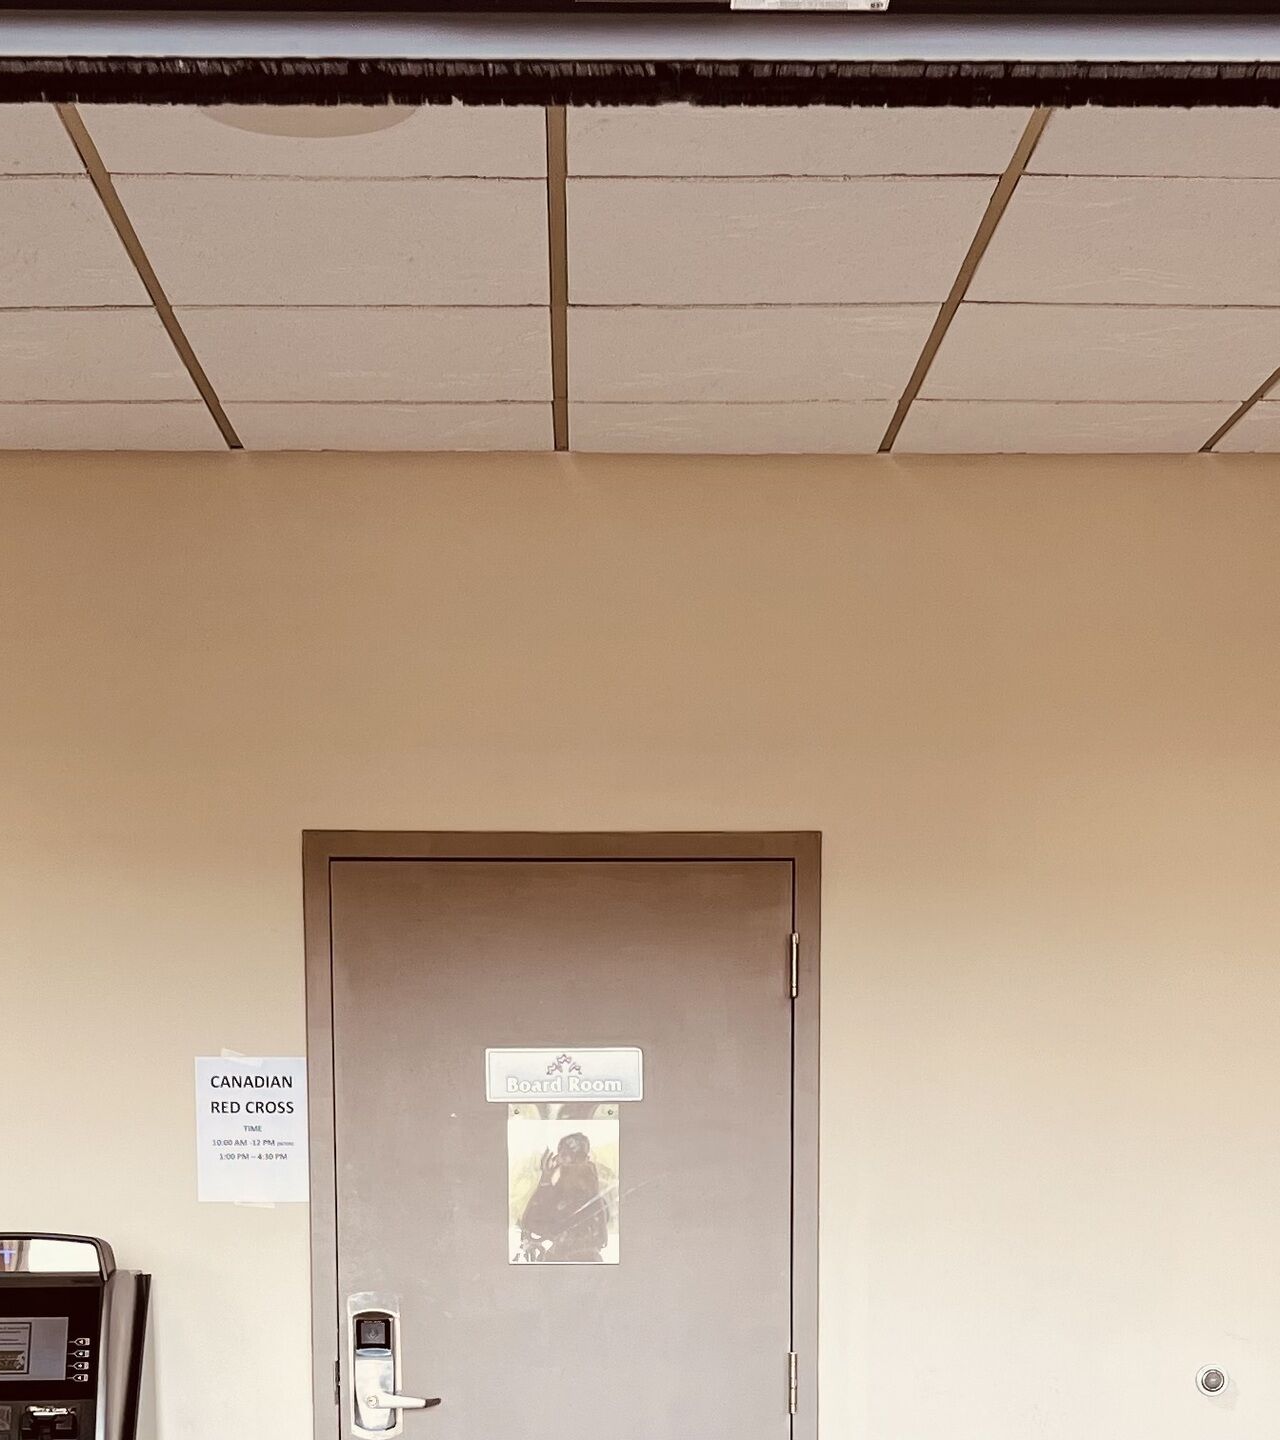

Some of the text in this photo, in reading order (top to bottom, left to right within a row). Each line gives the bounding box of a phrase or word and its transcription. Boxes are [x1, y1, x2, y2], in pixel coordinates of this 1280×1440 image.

[210, 1075, 294, 1089] CANADIAN
[507, 1076, 623, 1093] Board Room
[211, 1101, 295, 1115] RED CROSS
[243, 1125, 263, 1133] TIME
[212, 1139, 233, 1147] 10:00
[234, 1139, 248, 1147] AM
[263, 1139, 276, 1147] PM
[219, 1153, 235, 1161] 1:00
[236, 1153, 250, 1161] PM
[257, 1153, 274, 1161] 4:30
[275, 1153, 288, 1161] PM
